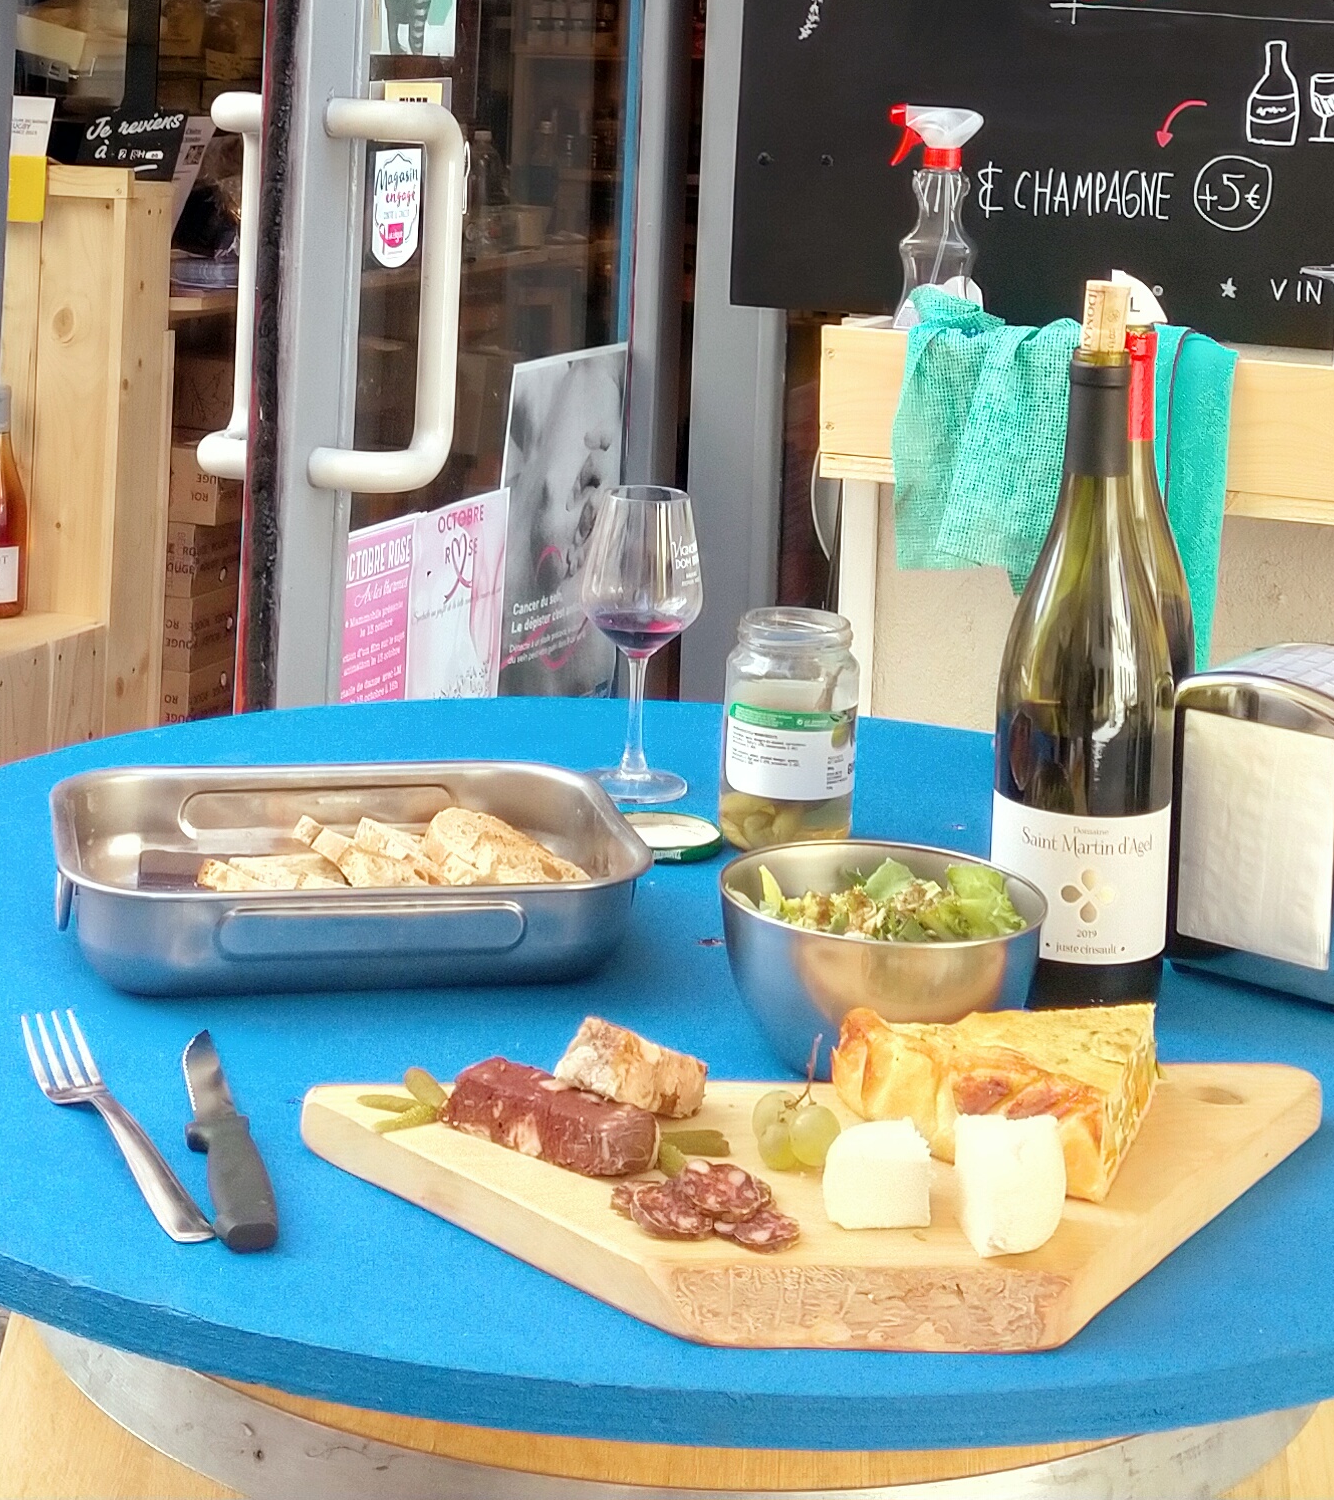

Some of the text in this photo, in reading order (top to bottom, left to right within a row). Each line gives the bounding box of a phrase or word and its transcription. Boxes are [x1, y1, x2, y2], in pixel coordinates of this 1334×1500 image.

[86, 112, 185, 140] Je reviens
[375, 168, 418, 196] Magasin
[1013, 167, 1176, 222] CHAMPAGNE
[1270, 276, 1322, 305] VIN
[438, 504, 484, 533] OCTOBRE
[388, 534, 412, 569] ROSE
[513, 600, 539, 615] Cancer
[1022, 826, 1153, 858] Saint Martin d'Agel
[1076, 929, 1098, 938] 2019
